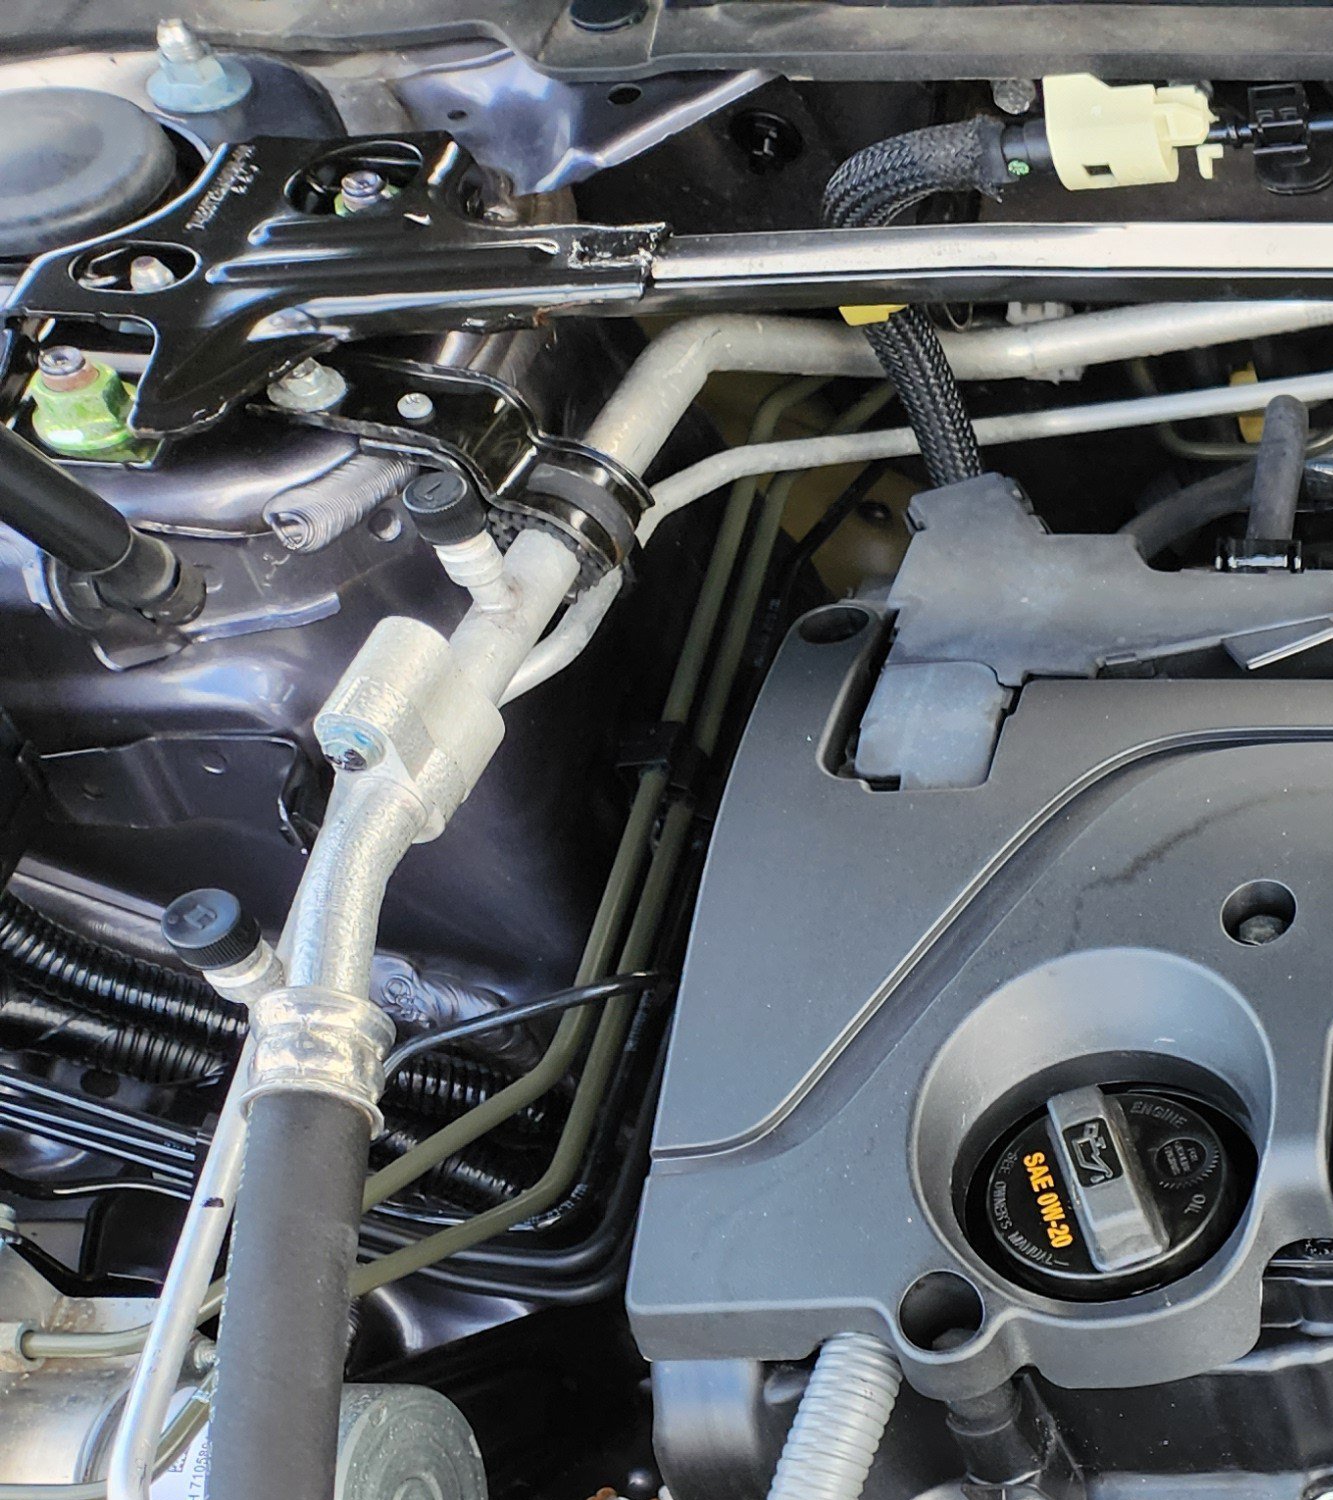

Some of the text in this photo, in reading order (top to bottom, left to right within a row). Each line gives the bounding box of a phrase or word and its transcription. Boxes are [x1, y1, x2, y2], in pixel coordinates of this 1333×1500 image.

[1130, 1101, 1188, 1129] ENGINE
[1023, 1151, 1074, 1249] SAE 0W-20
[1183, 1192, 1207, 1216] OIL
